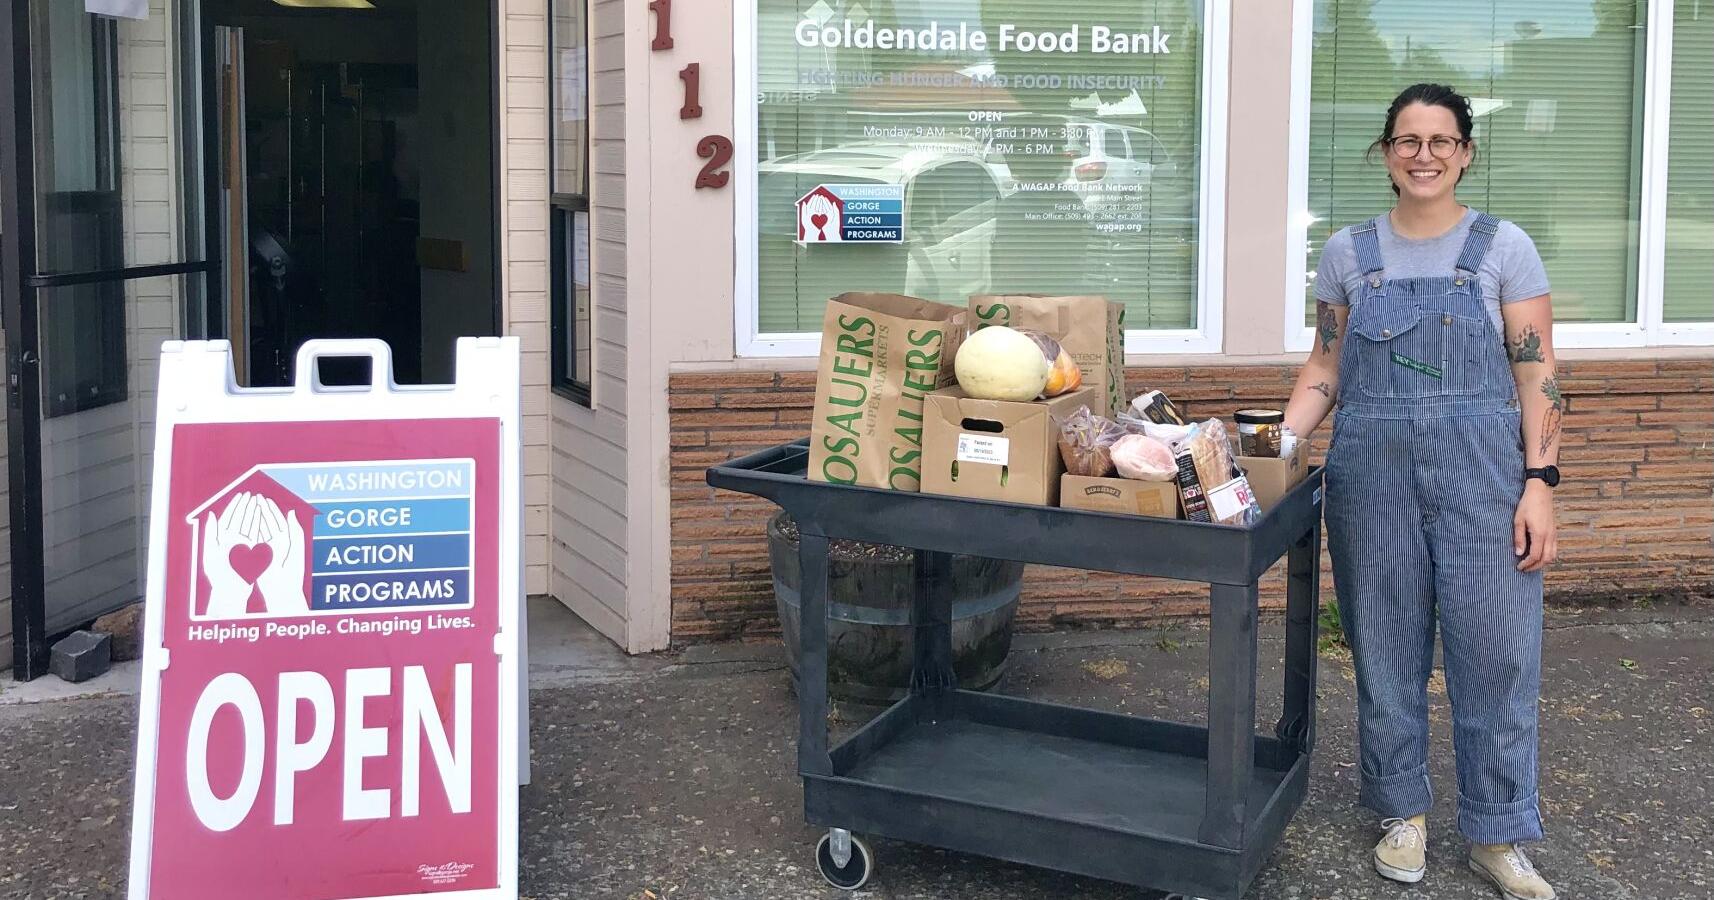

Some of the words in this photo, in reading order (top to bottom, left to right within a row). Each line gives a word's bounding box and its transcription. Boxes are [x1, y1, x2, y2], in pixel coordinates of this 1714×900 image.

[795, 18, 987, 51] Goldendale
[999, 24, 1079, 53] Food
[1091, 25, 1171, 54] Bank
[971, 73, 1008, 89] AND
[1013, 74, 1062, 89] FOOD
[1067, 75, 1167, 90] INSECURITY
[968, 110, 1003, 122] OPEN
[915, 126, 923, 137] 9
[926, 127, 946, 138] AM
[959, 127, 971, 139] 12
[974, 128, 993, 139] PM
[996, 127, 1017, 139] and
[1030, 128, 1048, 139] PM
[995, 143, 1014, 155] PM
[1025, 143, 1032, 154] 6
[1035, 144, 1054, 155] PM
[695, 135, 734, 189] 2
[839, 187, 899, 196] WASHINGTON
[1012, 183, 1019, 191] A
[1021, 183, 1055, 192] WAGAP
[1057, 183, 1079, 192] Food
[1081, 183, 1103, 192] Bank
[1105, 183, 1143, 192] Network
[847, 202, 880, 210] GORGE
[847, 216, 881, 225] ACTION
[1096, 222, 1142, 233] wagap.org
[847, 230, 897, 239] PROGRAMS
[865, 324, 890, 437] SUPERMARKETS
[307, 469, 463, 492] WASHINGTON
[326, 507, 412, 529] GORGE
[325, 543, 415, 567] ACTION
[324, 578, 455, 604] PROGRAMS
[188, 622, 260, 644] Helping
[265, 619, 331, 641] People.
[336, 616, 422, 637] Changing
[427, 613, 476, 631] Lives.
[186, 662, 473, 832] OPEN
